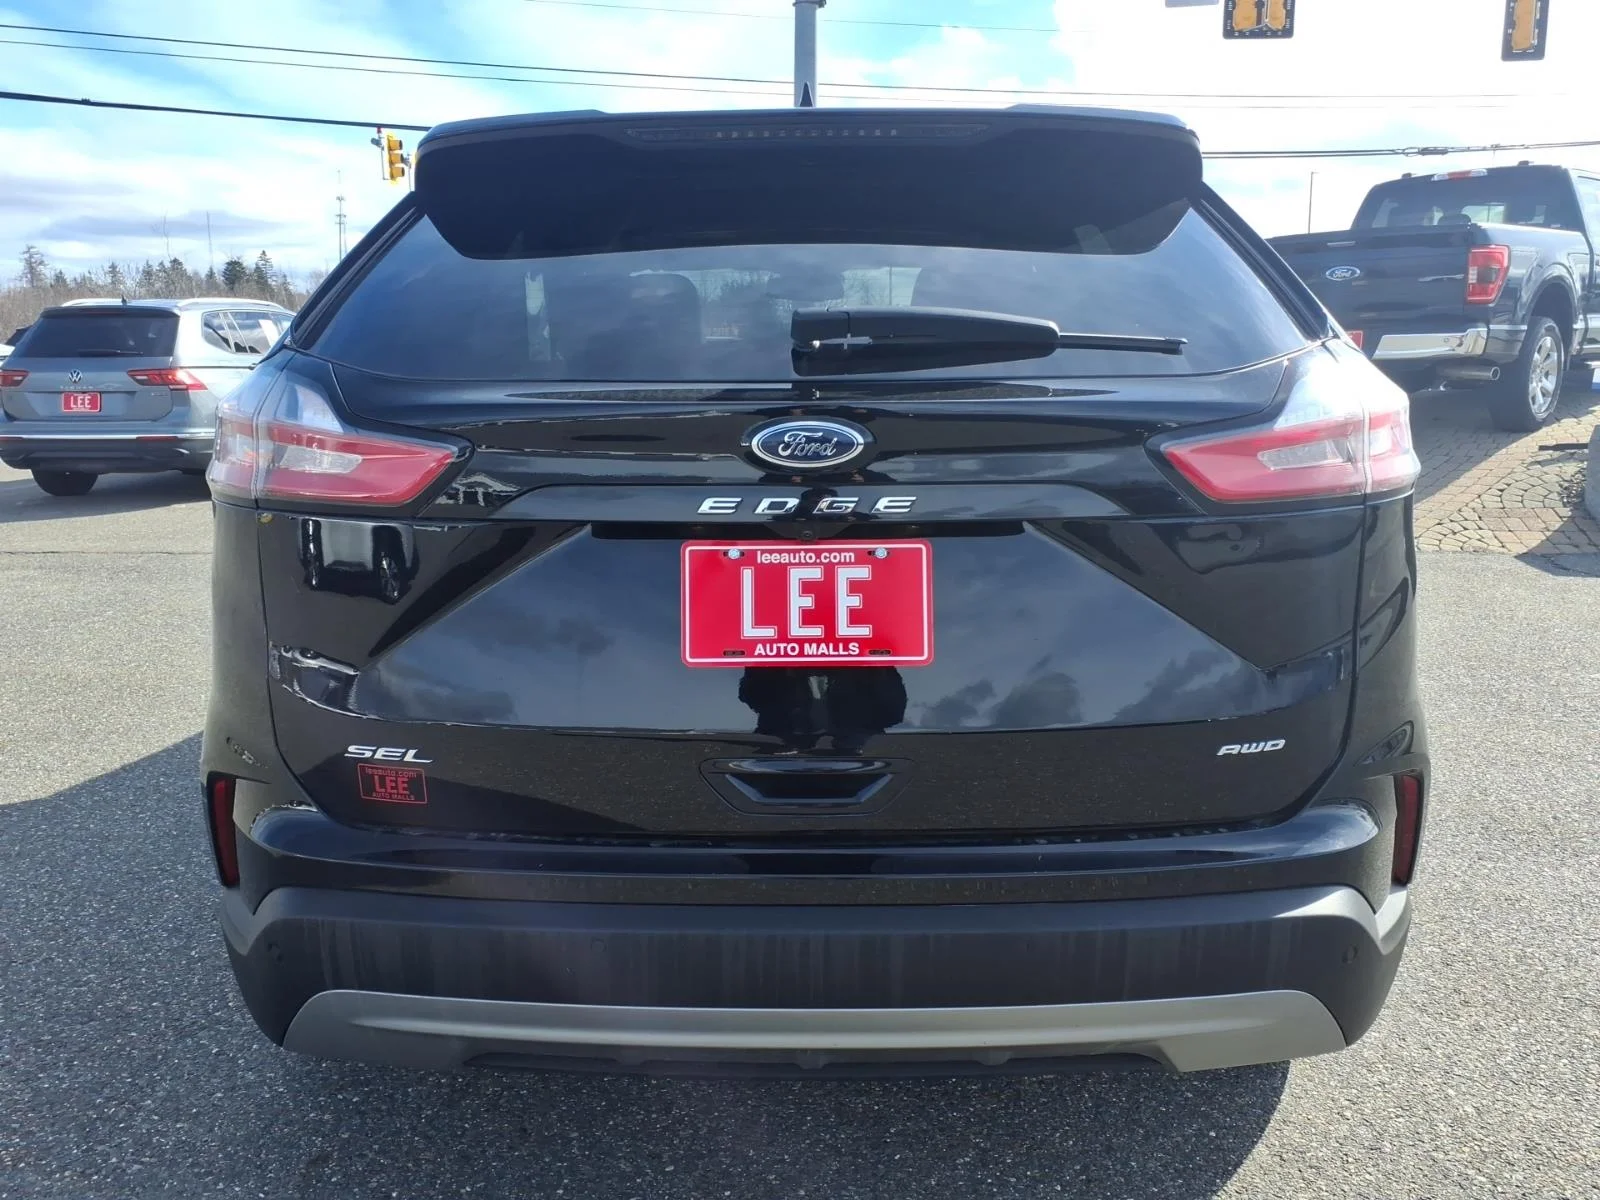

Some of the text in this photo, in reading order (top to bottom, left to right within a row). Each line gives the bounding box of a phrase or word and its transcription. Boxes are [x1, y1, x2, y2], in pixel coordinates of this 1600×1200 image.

[70, 395, 92, 408] LEE
[777, 431, 837, 457] Ford
[697, 496, 917, 515] EDGE
[756, 549, 855, 564] leeauto.com
[740, 565, 873, 640] LEE
[754, 642, 860, 657] AUTO MALLS
[343, 744, 434, 763] SEL
[1216, 739, 1286, 756] AWD
[374, 775, 410, 795] LEE
